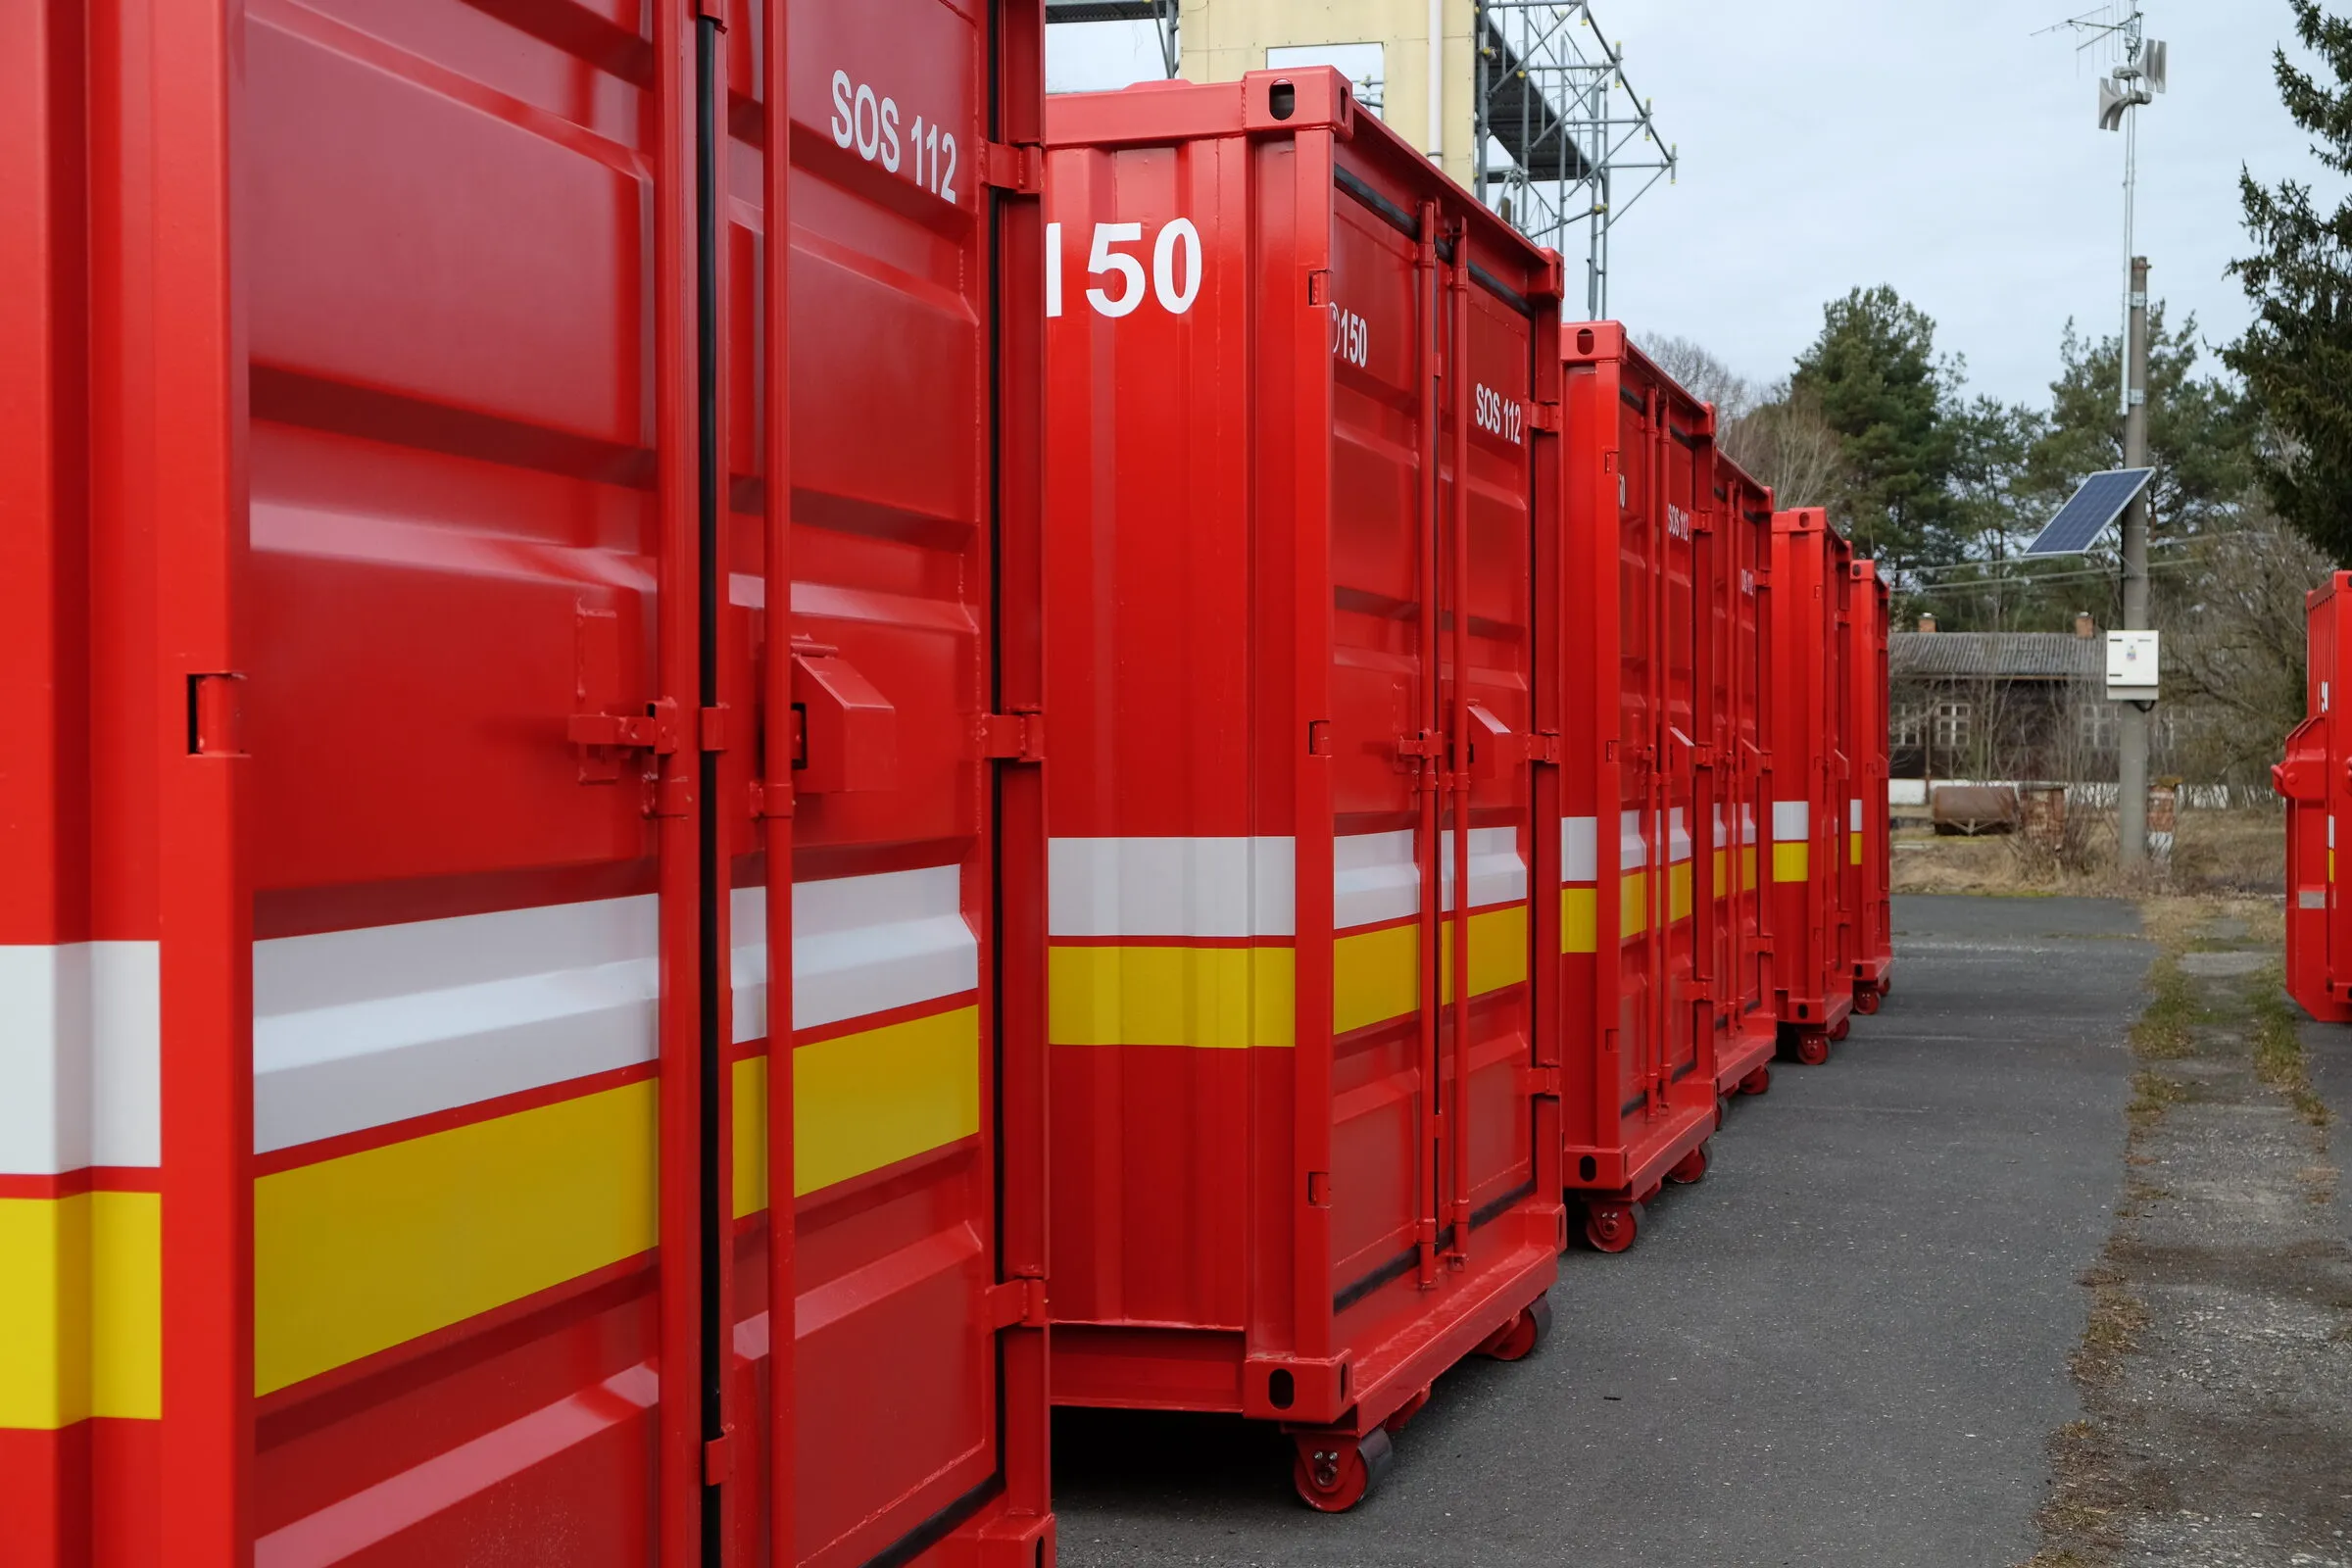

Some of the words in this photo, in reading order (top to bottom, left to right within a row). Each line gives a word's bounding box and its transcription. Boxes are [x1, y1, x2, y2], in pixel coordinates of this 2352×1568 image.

[831, 70, 901, 172] SOS
[910, 115, 956, 204] 112
[1046, 217, 1202, 318] 150
[1341, 308, 1367, 368] 150
[1476, 382, 1500, 434] SOS
[1503, 398, 1521, 445] 112
[1668, 503, 1680, 537] SOS
[1680, 511, 1689, 541] 112
